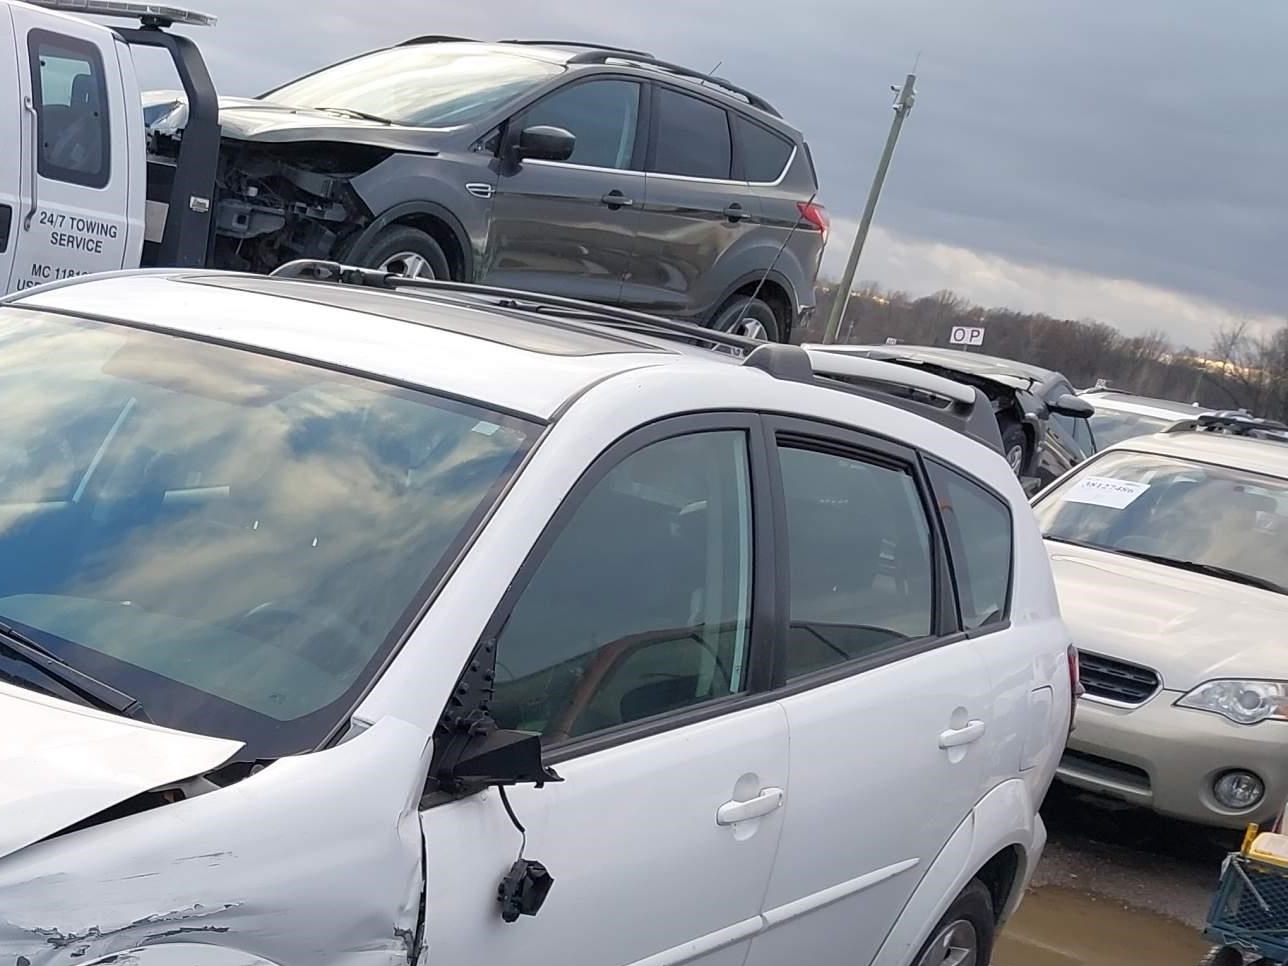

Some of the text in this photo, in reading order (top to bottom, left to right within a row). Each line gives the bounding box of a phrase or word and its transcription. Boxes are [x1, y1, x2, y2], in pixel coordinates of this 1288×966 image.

[39, 211, 118, 239] 24/7 TOWING
[50, 231, 103, 254] SERVICE
[31, 263, 51, 279] MC
